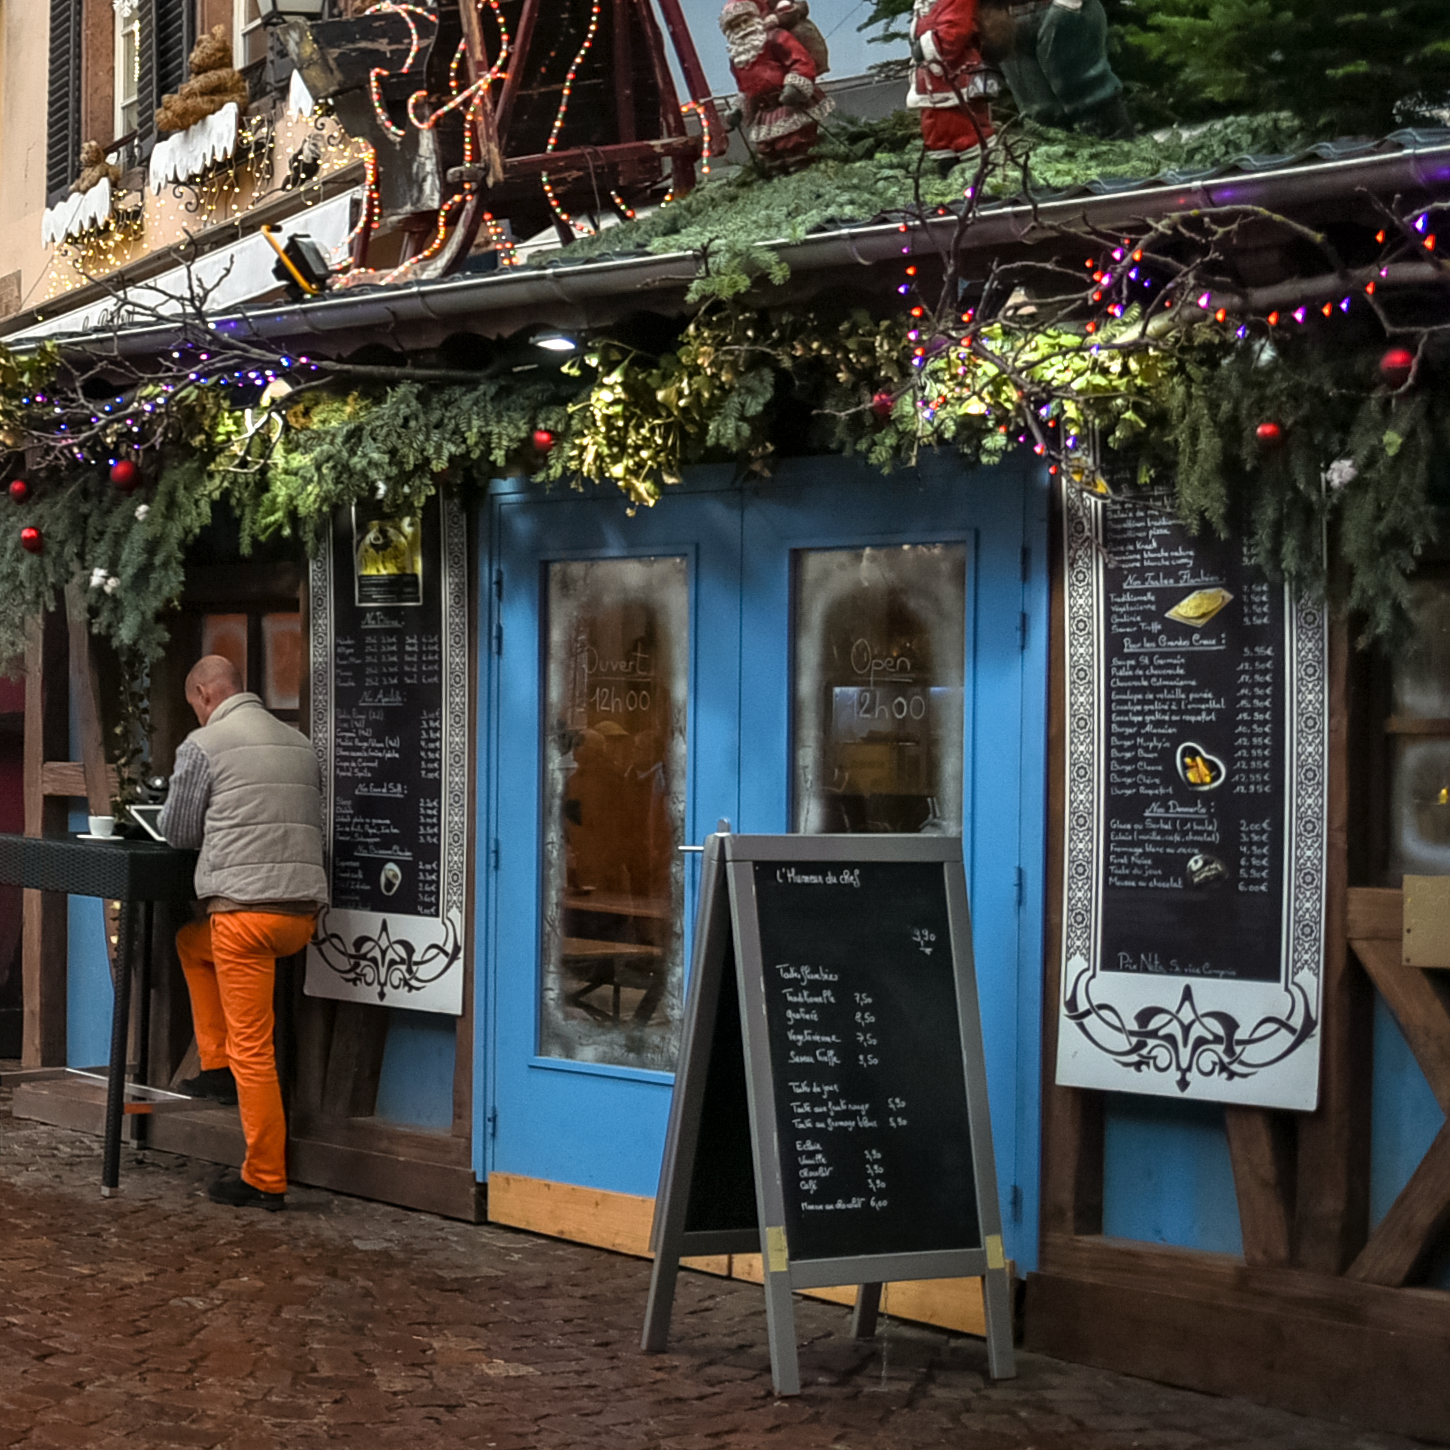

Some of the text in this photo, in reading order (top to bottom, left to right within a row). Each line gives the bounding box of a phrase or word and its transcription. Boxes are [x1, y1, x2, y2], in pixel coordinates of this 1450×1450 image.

[1124, 573, 1141, 585] Nos
[850, 638, 911, 689] Open
[1111, 723, 1138, 735] Burger
[1110, 736, 1135, 748] Burger
[1110, 748, 1136, 760] Burger
[1110, 760, 1136, 772] Burger
[1110, 772, 1136, 785] Burger
[1110, 786, 1136, 797] Burger
[1145, 801, 1165, 813] Nos
[825, 870, 838, 885] du
[839, 868, 861, 888] chef
